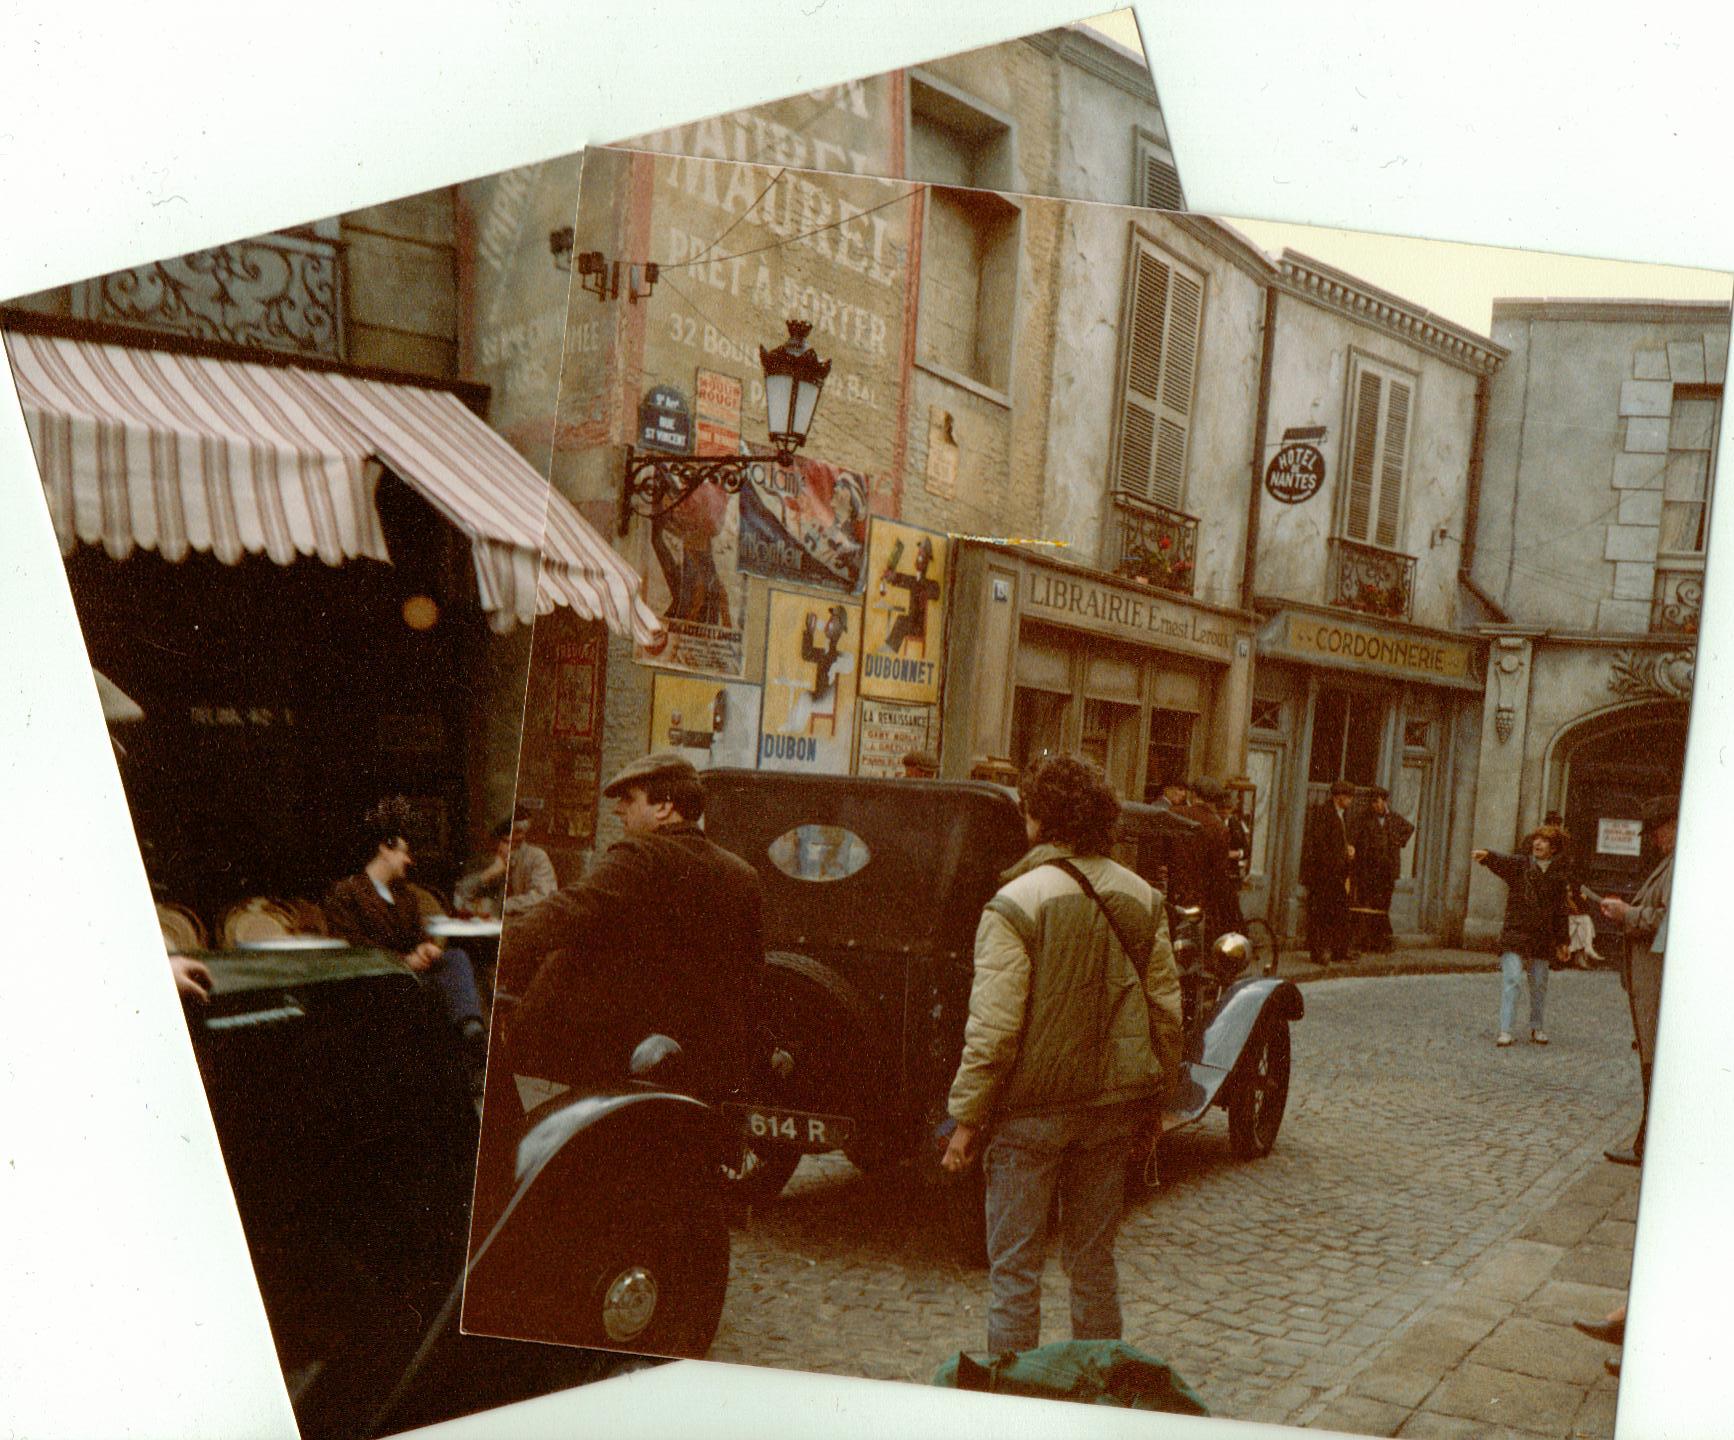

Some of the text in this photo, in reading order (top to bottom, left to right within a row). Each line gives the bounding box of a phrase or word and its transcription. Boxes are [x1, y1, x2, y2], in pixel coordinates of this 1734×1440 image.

[669, 312, 698, 348] 32
[1279, 447, 1318, 471] HOTEL
[1270, 471, 1317, 490] NANTES
[1029, 572, 1145, 629] LIBRAIRIE
[1316, 626, 1445, 672] CORDONNERIE
[864, 653, 935, 686] DUBONNET
[878, 711, 928, 729] RENAISSANCE
[764, 733, 817, 762] DUBON
[750, 1113, 826, 1143] 614 R
